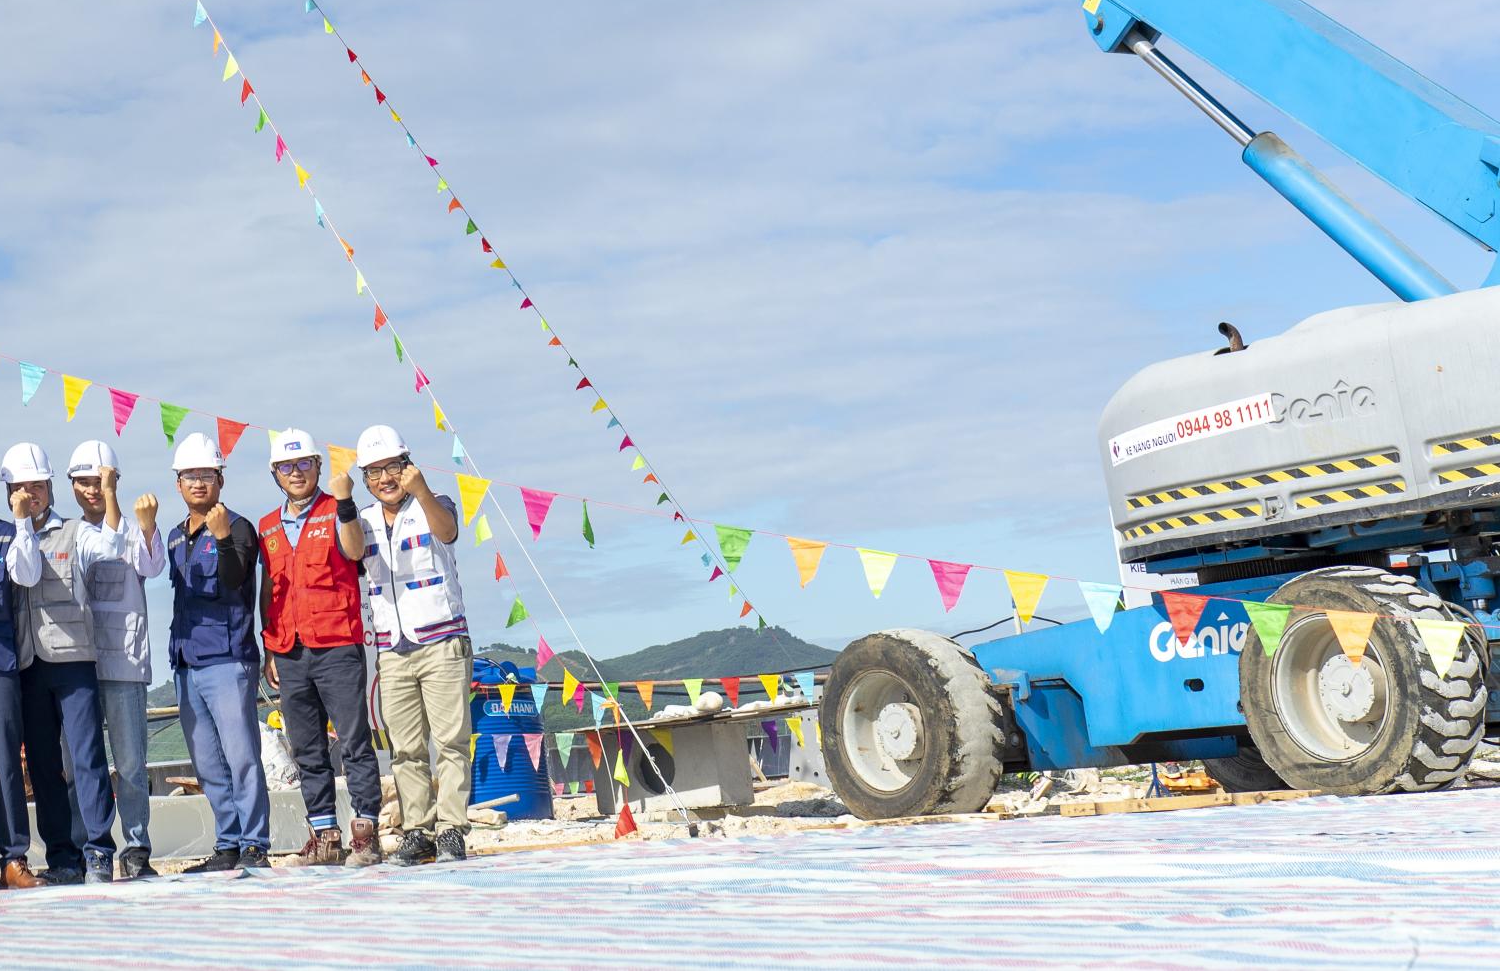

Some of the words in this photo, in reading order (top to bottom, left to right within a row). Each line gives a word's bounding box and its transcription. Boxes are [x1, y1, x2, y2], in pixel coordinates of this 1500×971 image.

[1125, 446, 1133, 456] XE
[1176, 415, 1211, 438] 0944
[1214, 409, 1233, 429] 98
[1236, 399, 1271, 423] 1111
